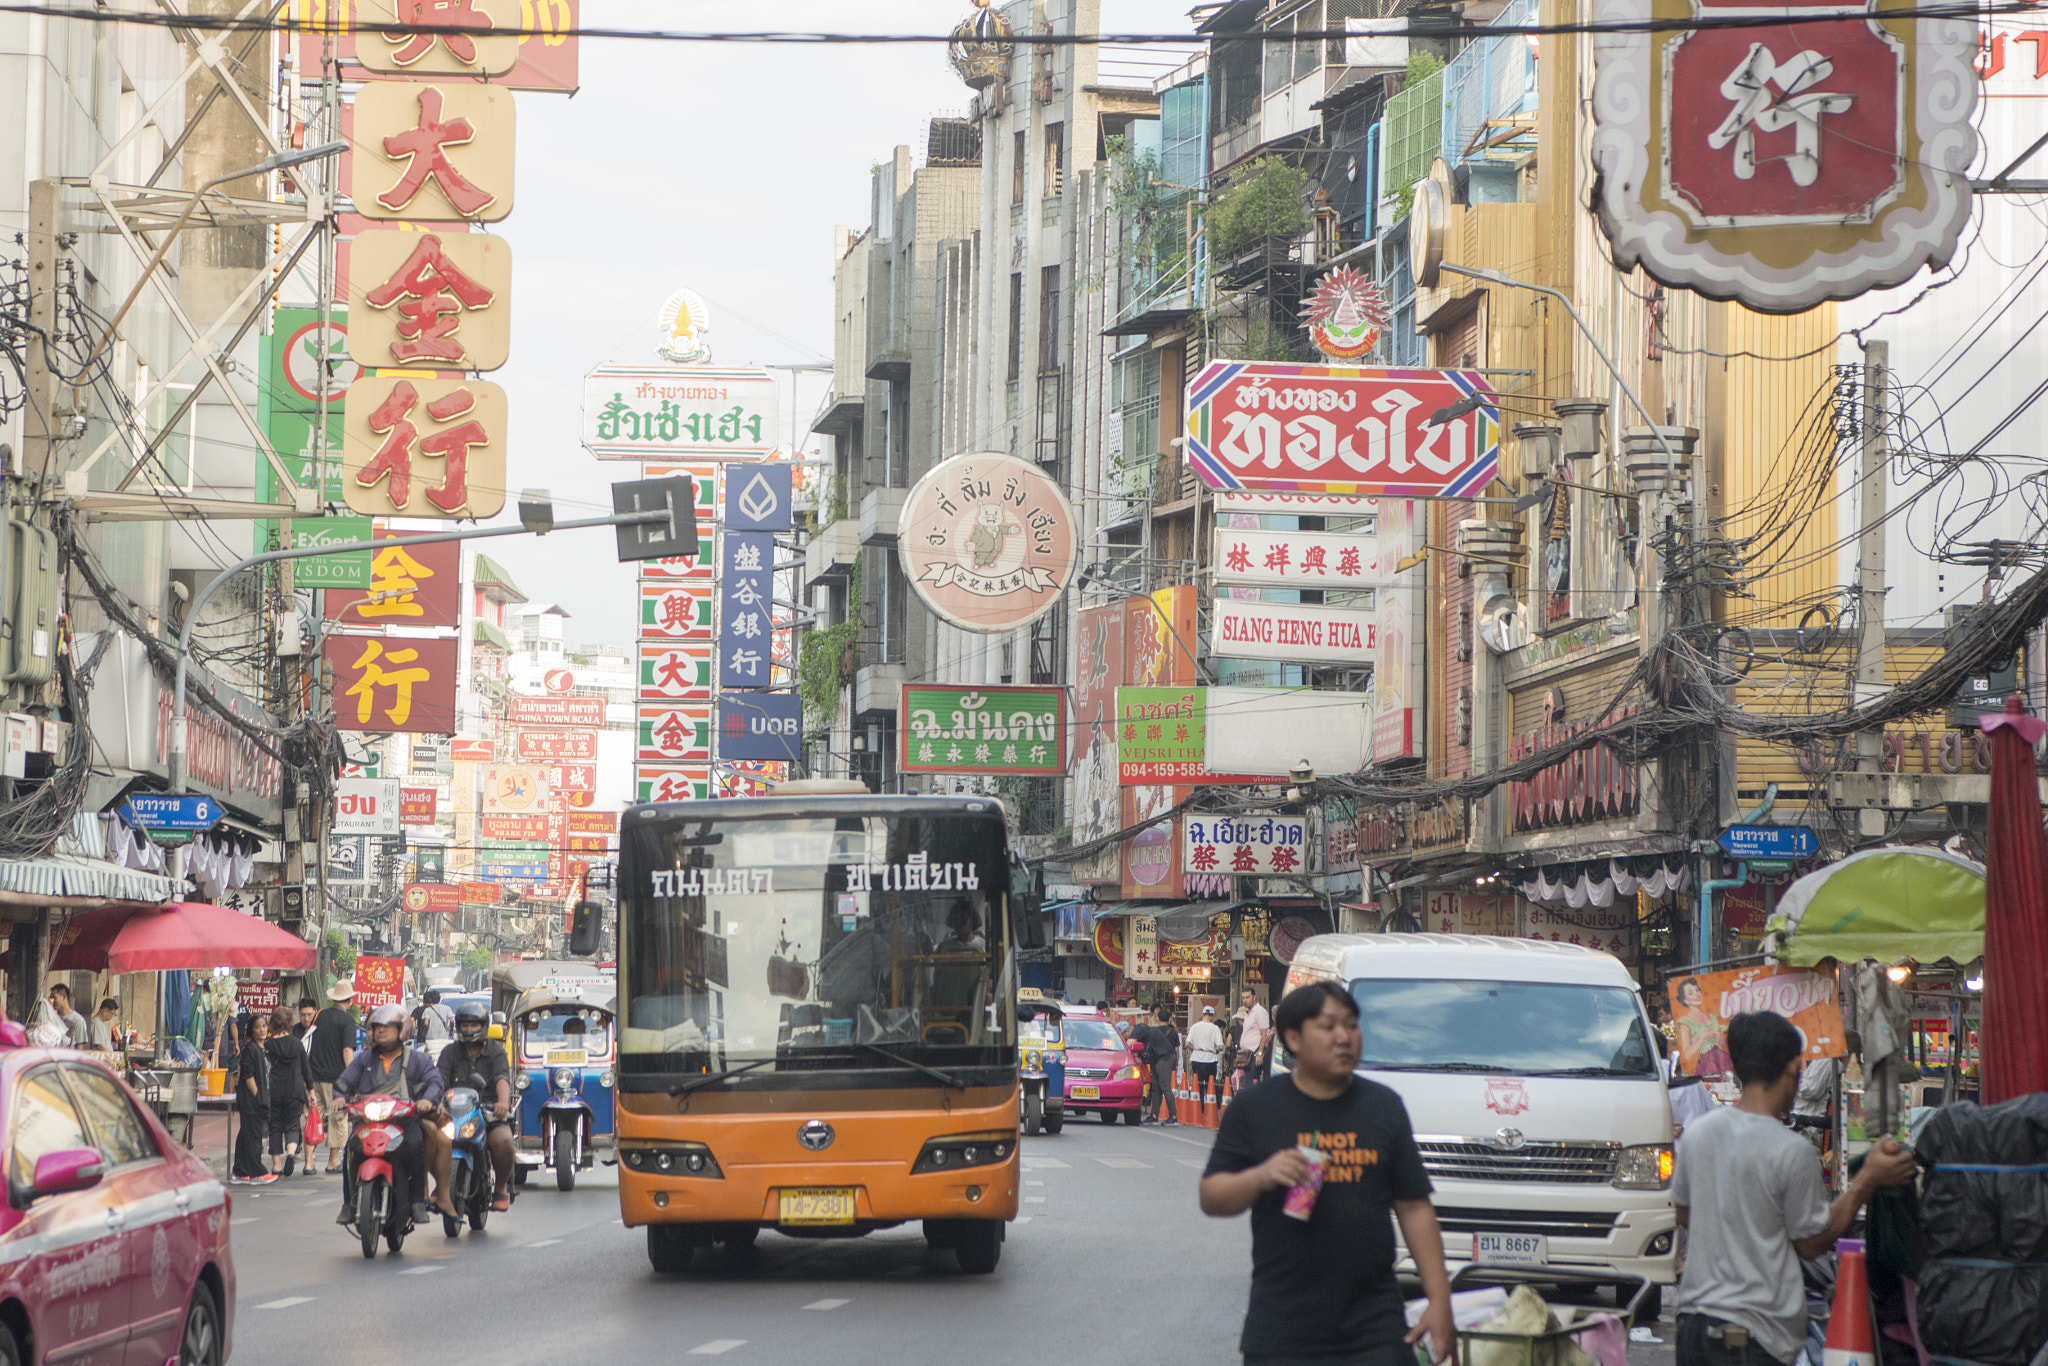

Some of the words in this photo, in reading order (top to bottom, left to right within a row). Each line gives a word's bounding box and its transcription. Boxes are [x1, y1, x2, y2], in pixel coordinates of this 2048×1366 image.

[1708, 42, 1854, 187] 行
[636, 381, 728, 400] ห้างขายทอง
[1235, 377, 1357, 412] ห้างทอง
[597, 392, 763, 443] ฮั่วเซ่งเฮง
[1219, 388, 1467, 475] ทองใบ
[1225, 542, 1377, 576] 林祥興藥
[296, 565, 361, 578] ISDOM
[729, 541, 763, 677] 盤谷銀行
[1223, 616, 1273, 643] SIANG
[1277, 620, 1322, 646] HENG
[1328, 622, 1362, 649] HUA
[1367, 624, 1376, 650] K
[1125, 693, 1195, 721] เวชศรี
[515, 714, 542, 723] CHINA
[544, 715, 570, 724] TOWN
[572, 715, 600, 724] SCALA
[751, 717, 798, 736] UOB
[911, 692, 1056, 742] ฉ.มั่นคง
[1123, 724, 1205, 744] 華聯藥
[1123, 747, 1172, 763] VEJSRI
[1177, 748, 1205, 759] THA
[196, 802, 208, 820] 6
[1731, 830, 1779, 842] เยาวราช
[651, 867, 774, 897] ถนนตก
[985, 1004, 1002, 1032] 1
[1318, 1131, 1357, 1149] NOT
[1332, 1148, 1378, 1166] THEN
[1324, 1165, 1364, 1183] EN?
[786, 1196, 848, 1215] 14-7381
[1506, 1237, 1539, 1253] 8667
